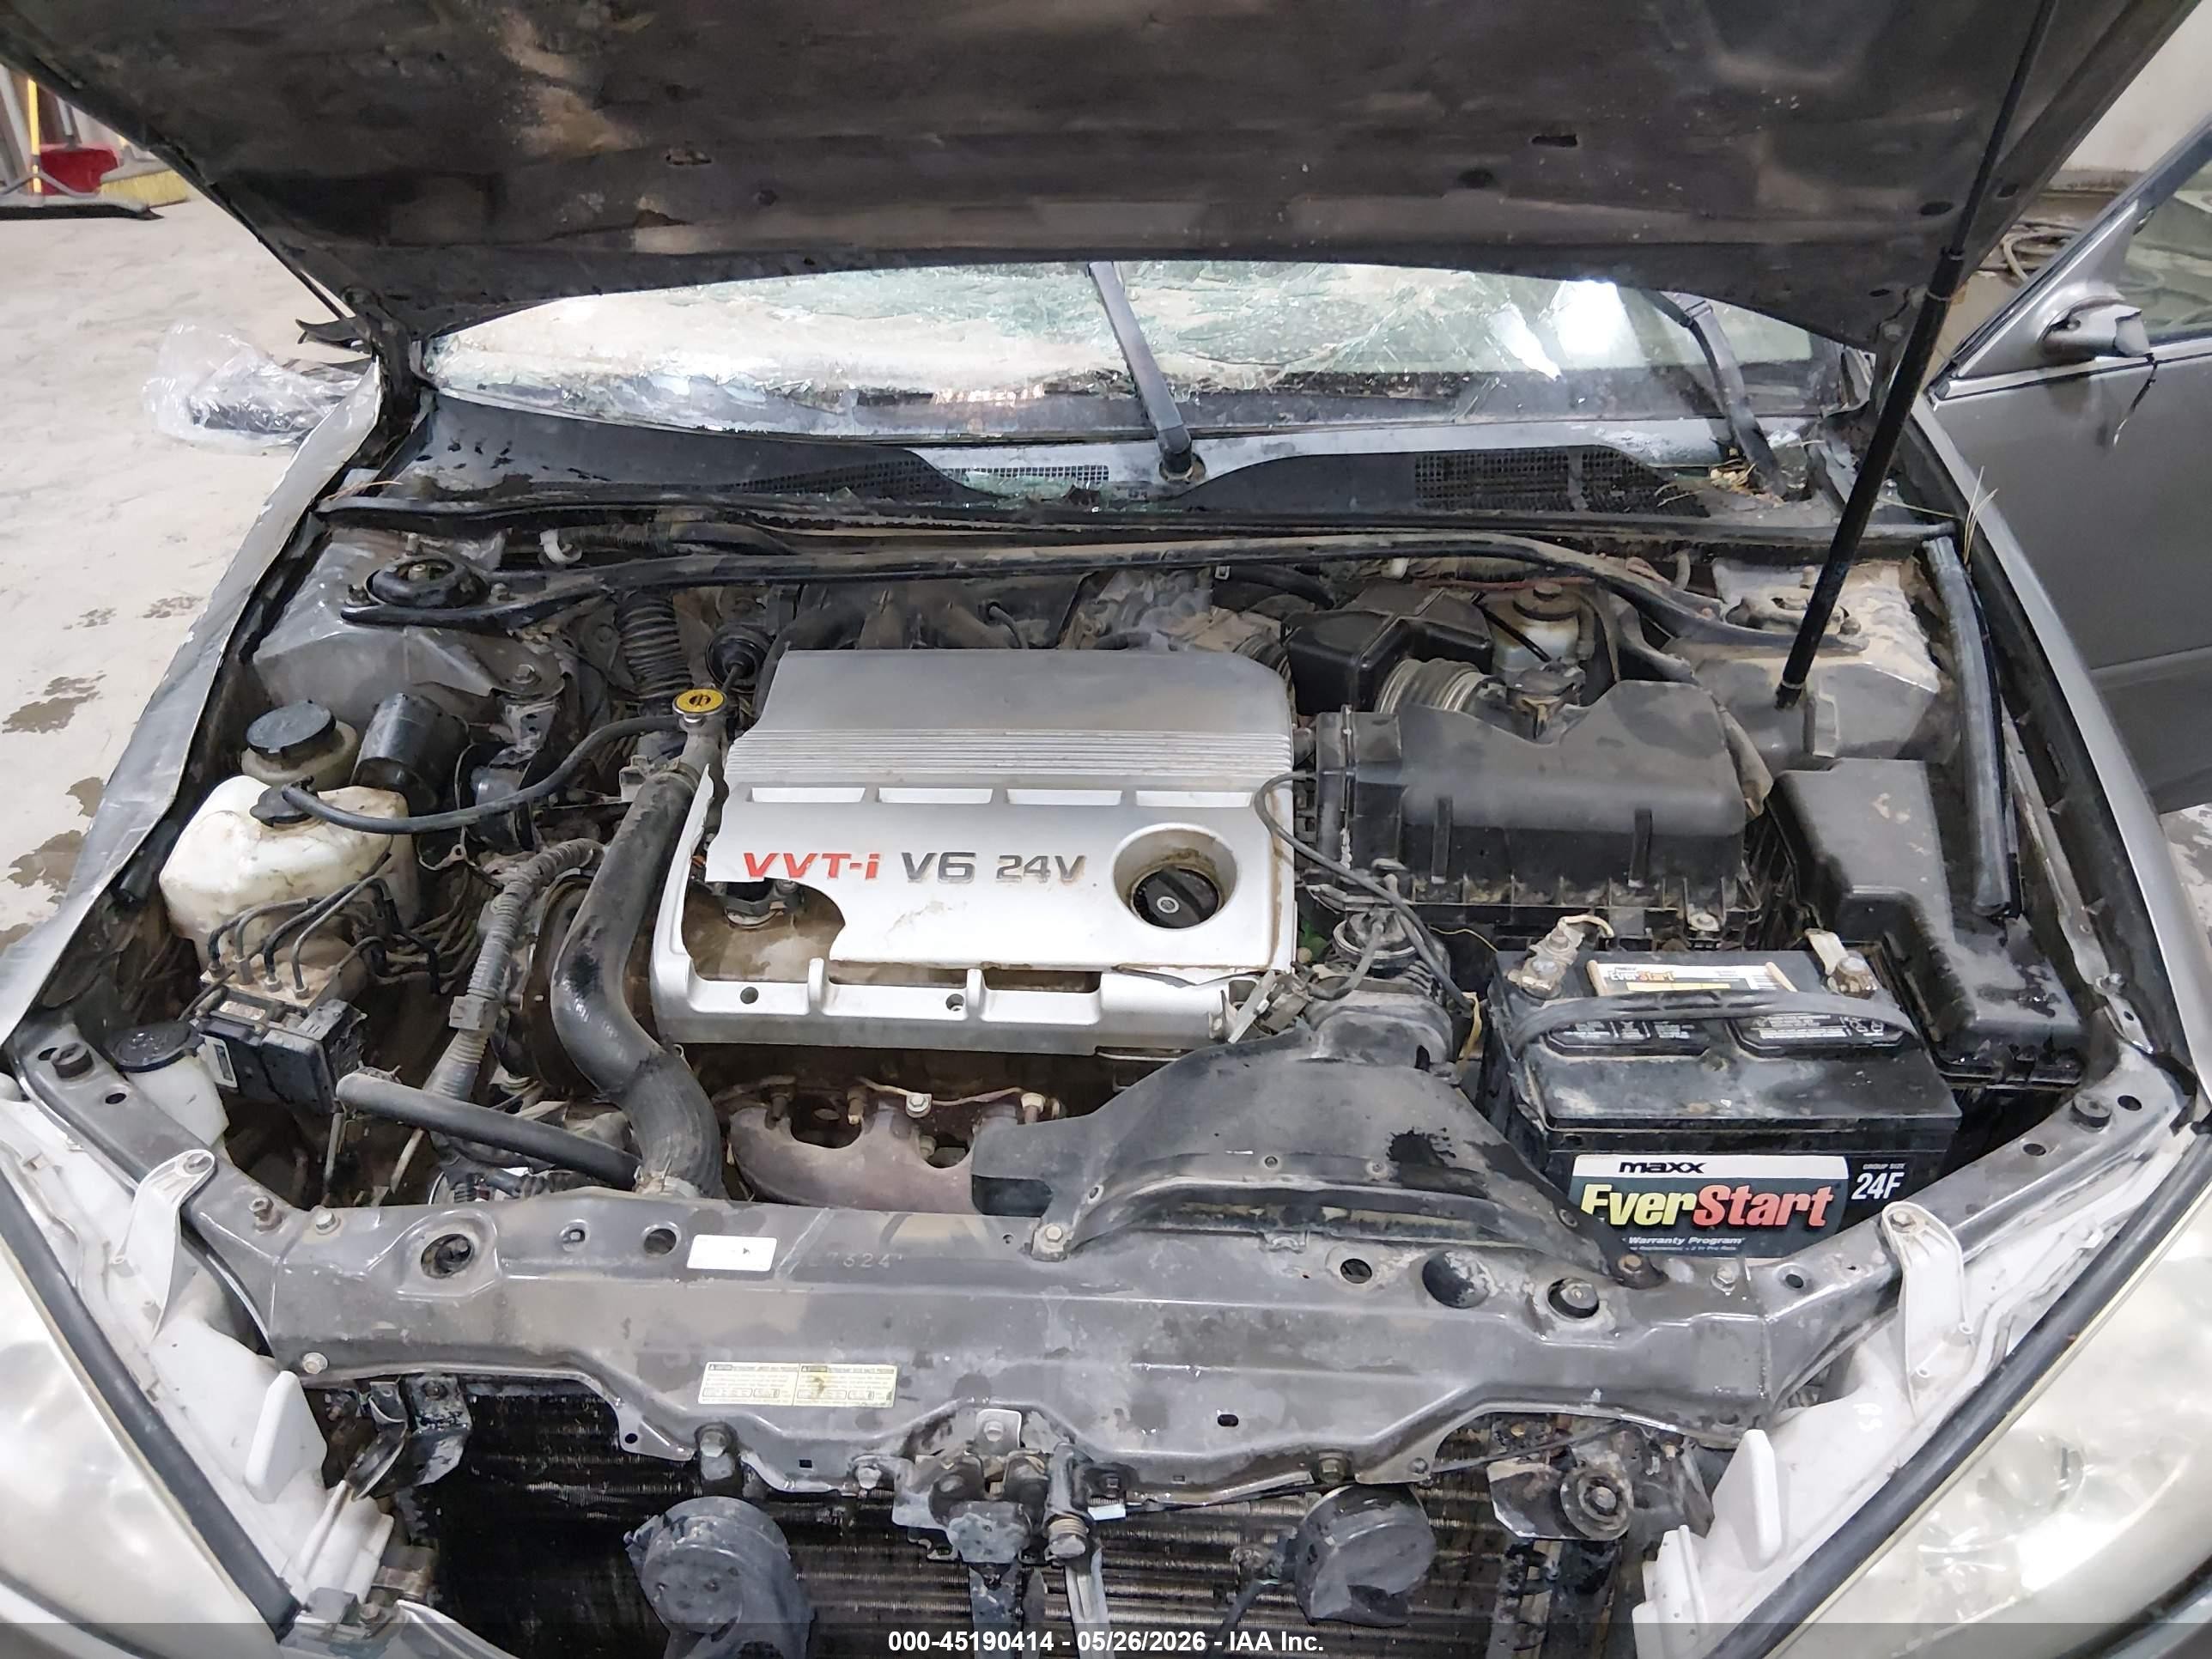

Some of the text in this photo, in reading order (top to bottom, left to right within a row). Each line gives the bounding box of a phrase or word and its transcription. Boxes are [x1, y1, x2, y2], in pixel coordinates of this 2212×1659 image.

[744, 851, 1086, 883] VVT-i V6 24V
[1619, 1161, 1706, 1174] maxx
[1850, 1171, 1905, 1200] 24F
[1581, 1183, 1834, 1227] EverStart
[1628, 1237, 1685, 1245] Warranty
